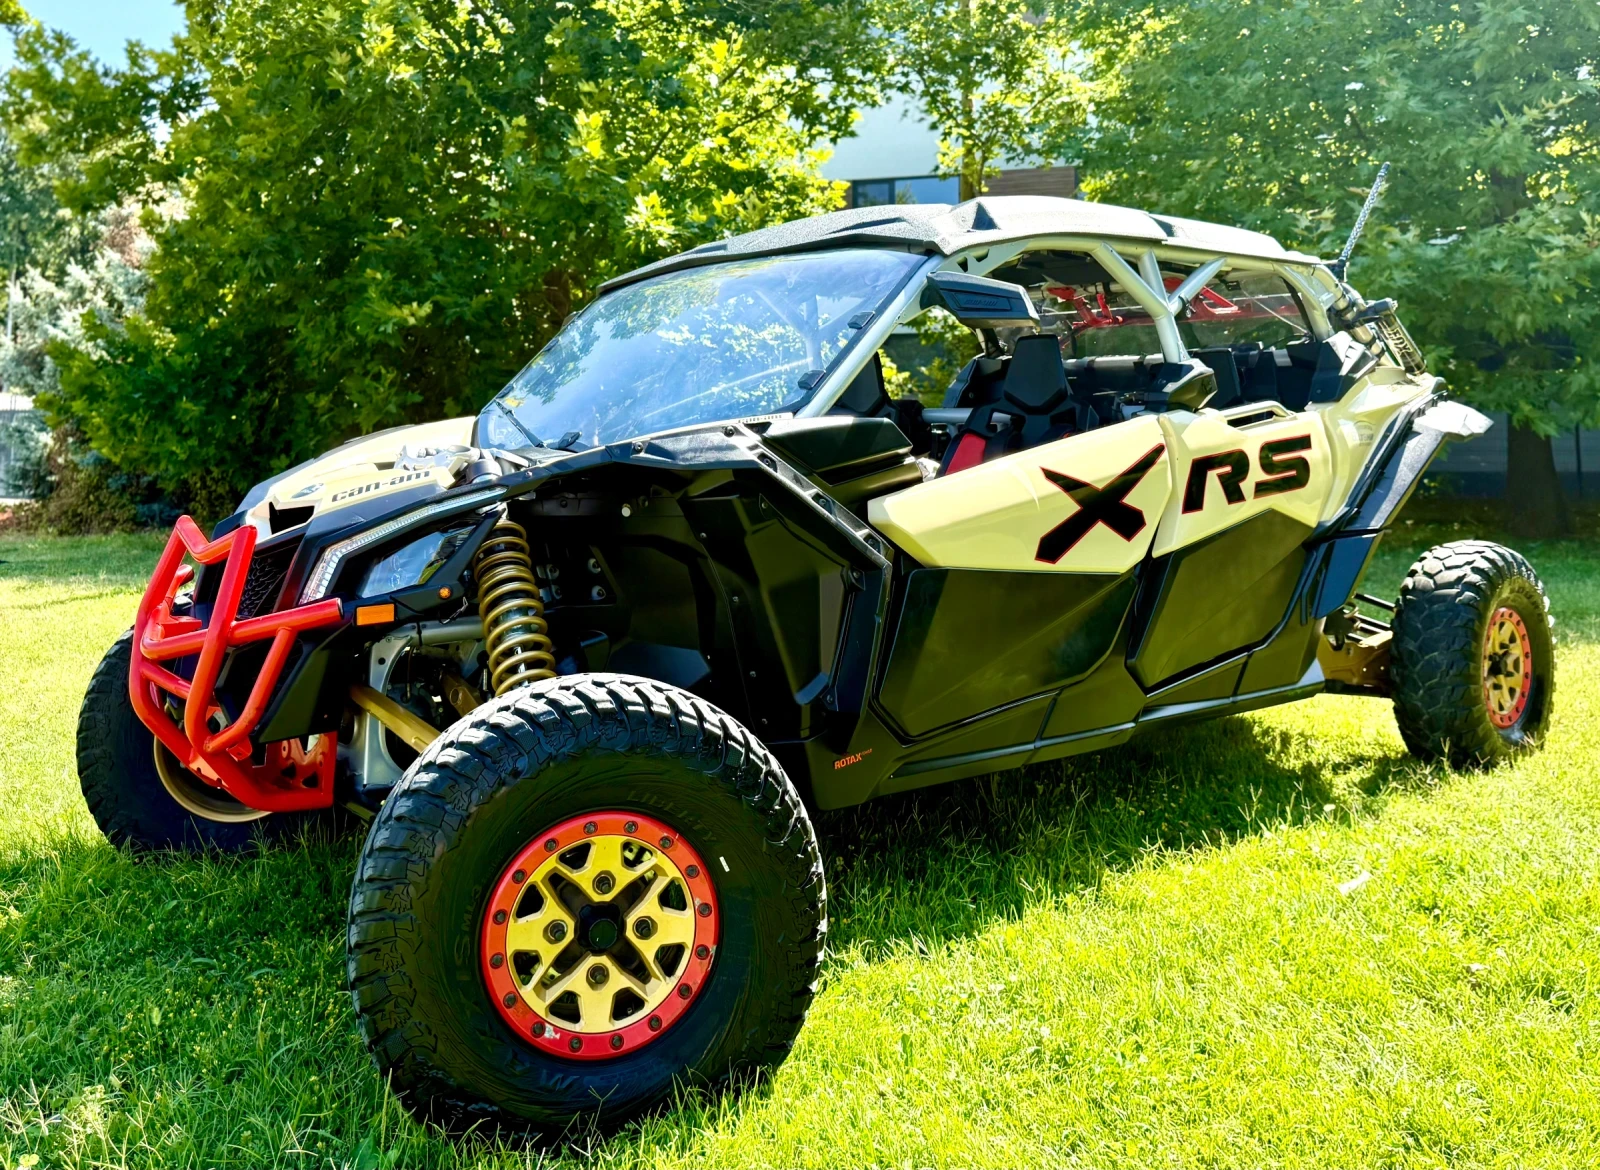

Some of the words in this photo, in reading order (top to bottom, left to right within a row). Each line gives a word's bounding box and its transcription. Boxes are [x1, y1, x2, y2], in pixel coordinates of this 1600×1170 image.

[1388, 327, 1413, 356] FOX
[331, 470, 430, 503] can-am
[1034, 442, 1166, 565] X
[1182, 433, 1312, 514] RS
[834, 752, 862, 770] ROTAX
